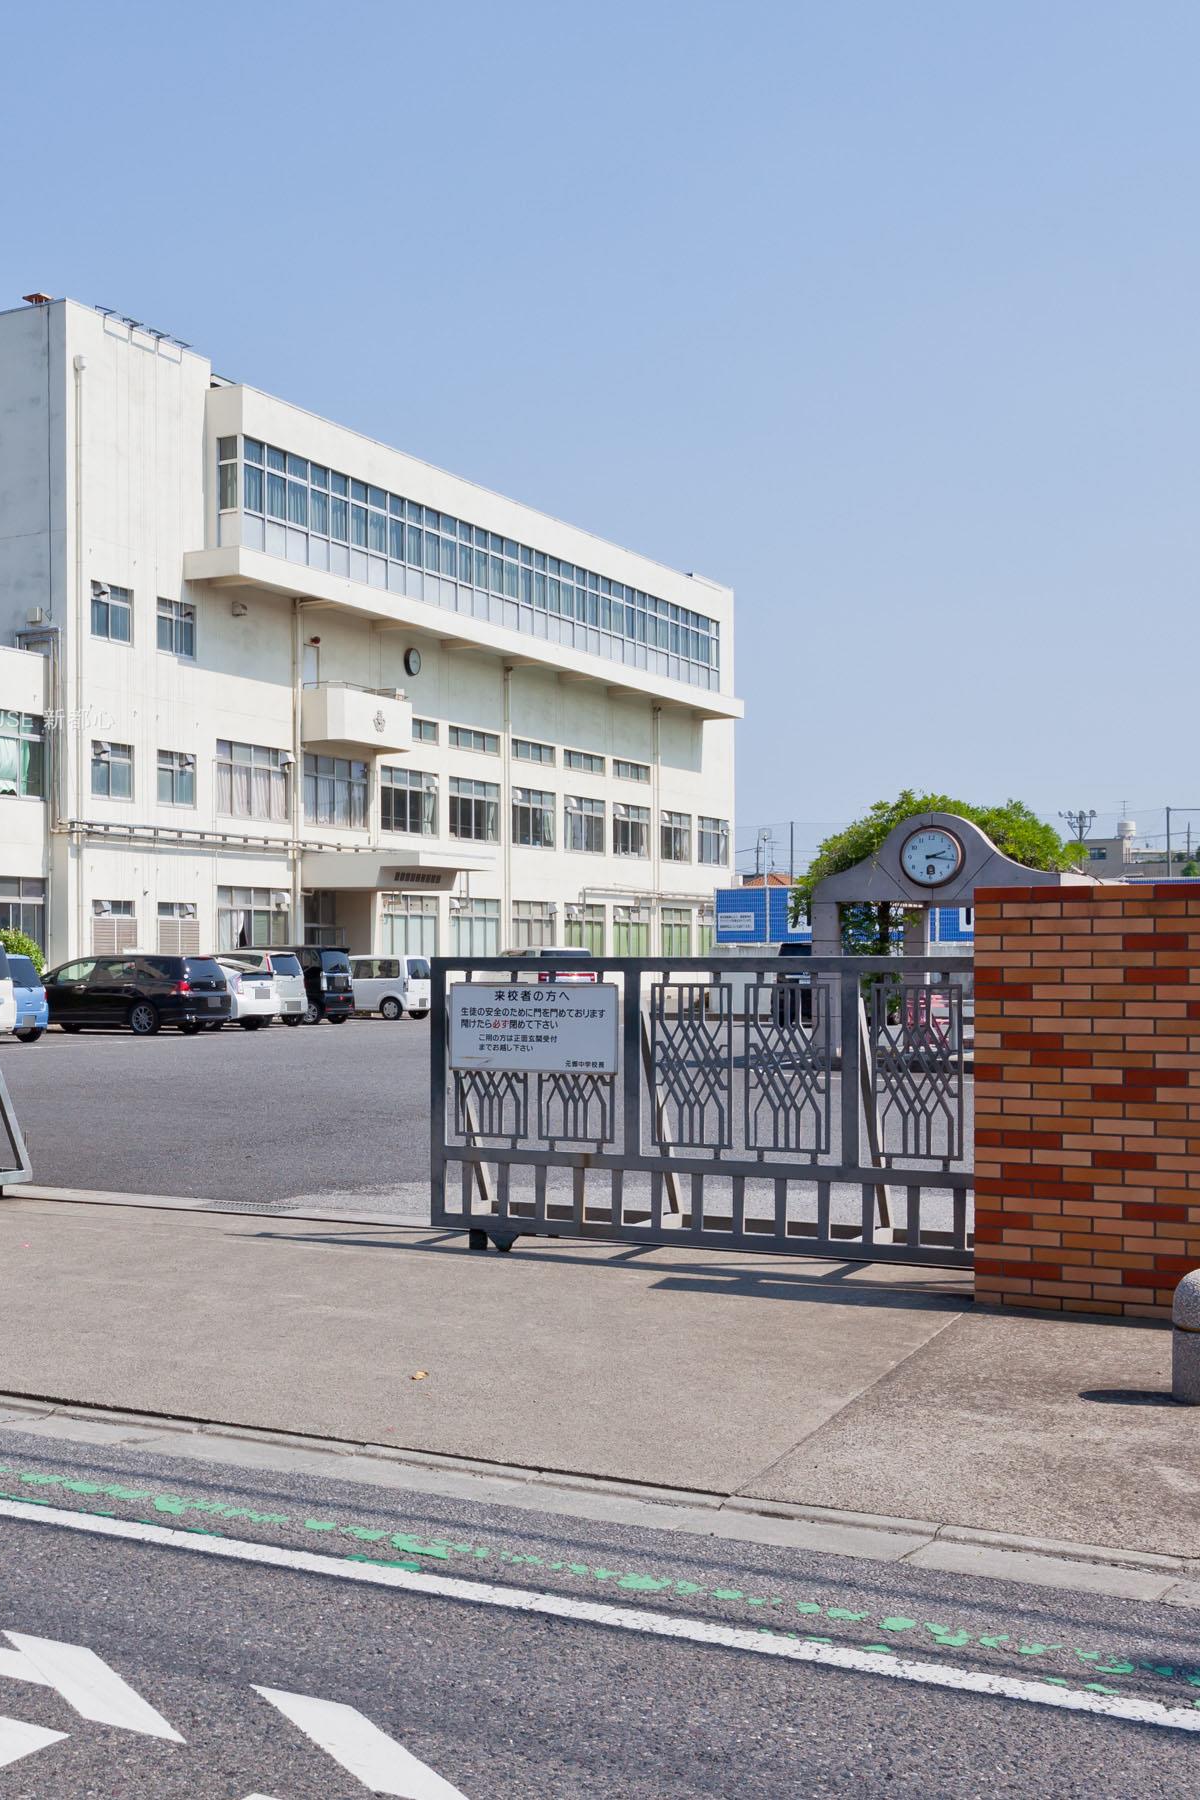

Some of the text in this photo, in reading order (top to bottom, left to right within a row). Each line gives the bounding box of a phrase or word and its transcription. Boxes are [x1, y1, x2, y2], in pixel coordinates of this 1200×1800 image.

[494, 990, 570, 1002] 来校者の方へ
